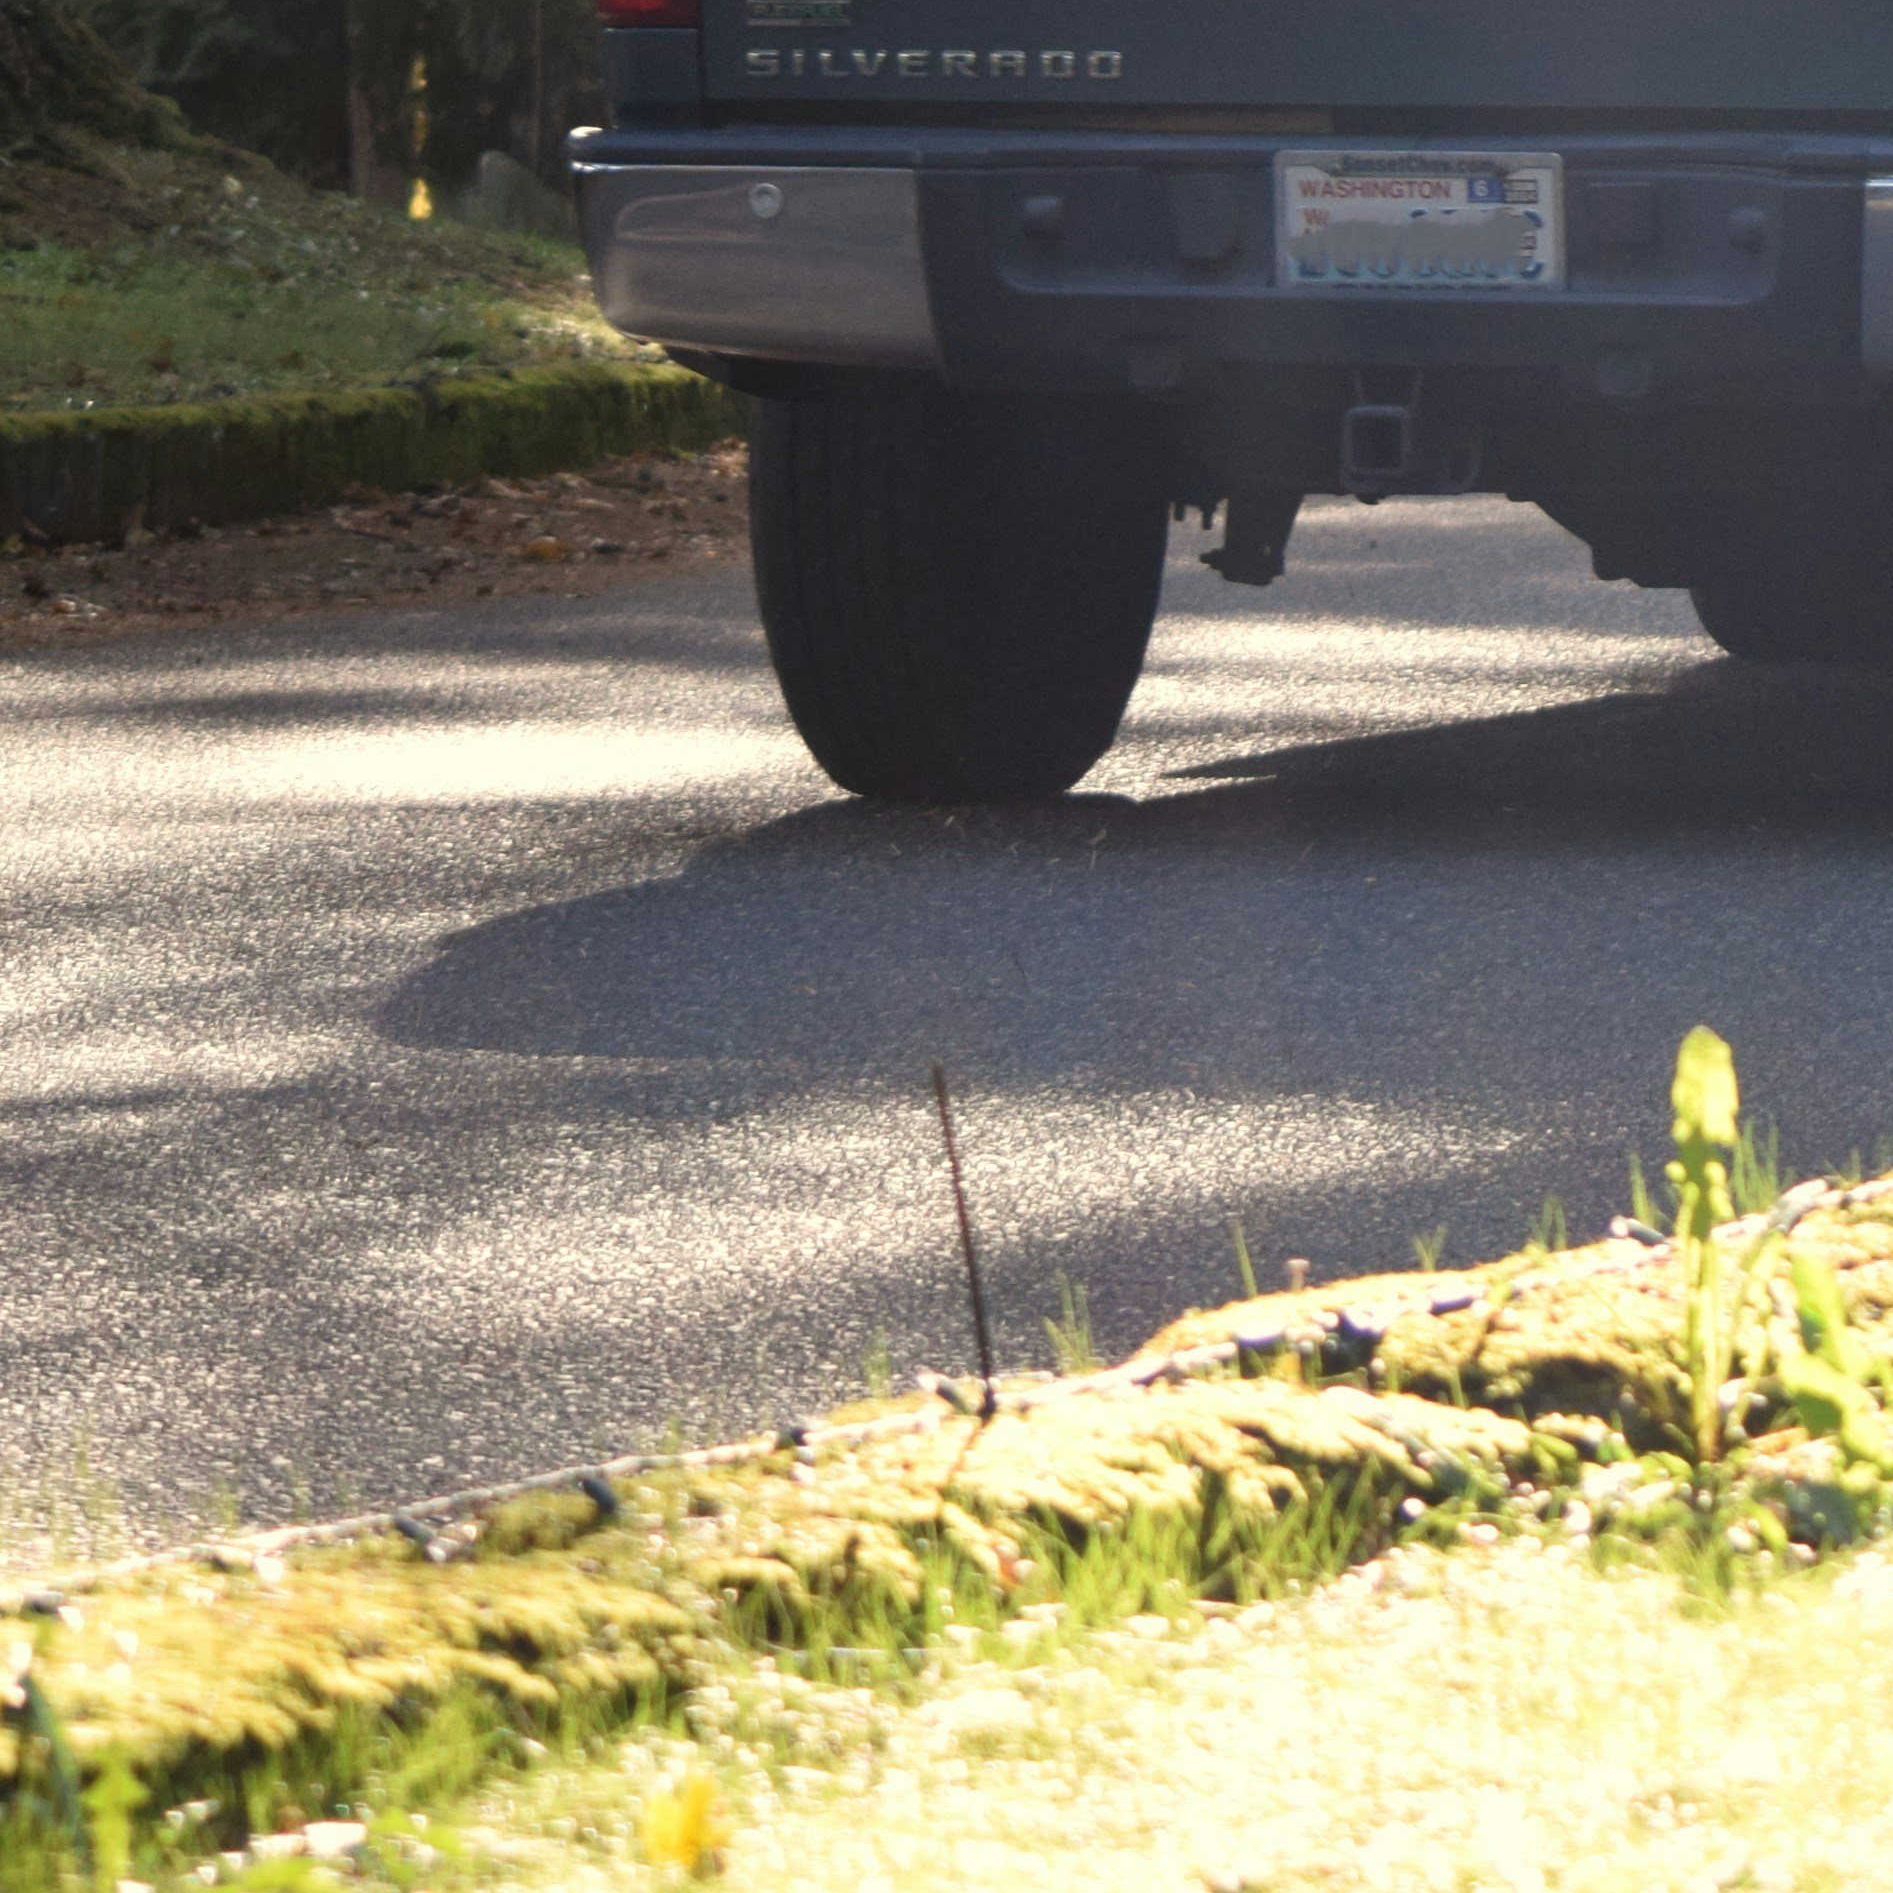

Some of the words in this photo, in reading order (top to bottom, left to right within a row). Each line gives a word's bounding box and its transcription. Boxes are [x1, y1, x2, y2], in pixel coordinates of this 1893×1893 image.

[745, 49, 1123, 79] SILVERADO
[1298, 178, 1452, 199] WASHINGTON
[1474, 179, 1490, 198] 6
